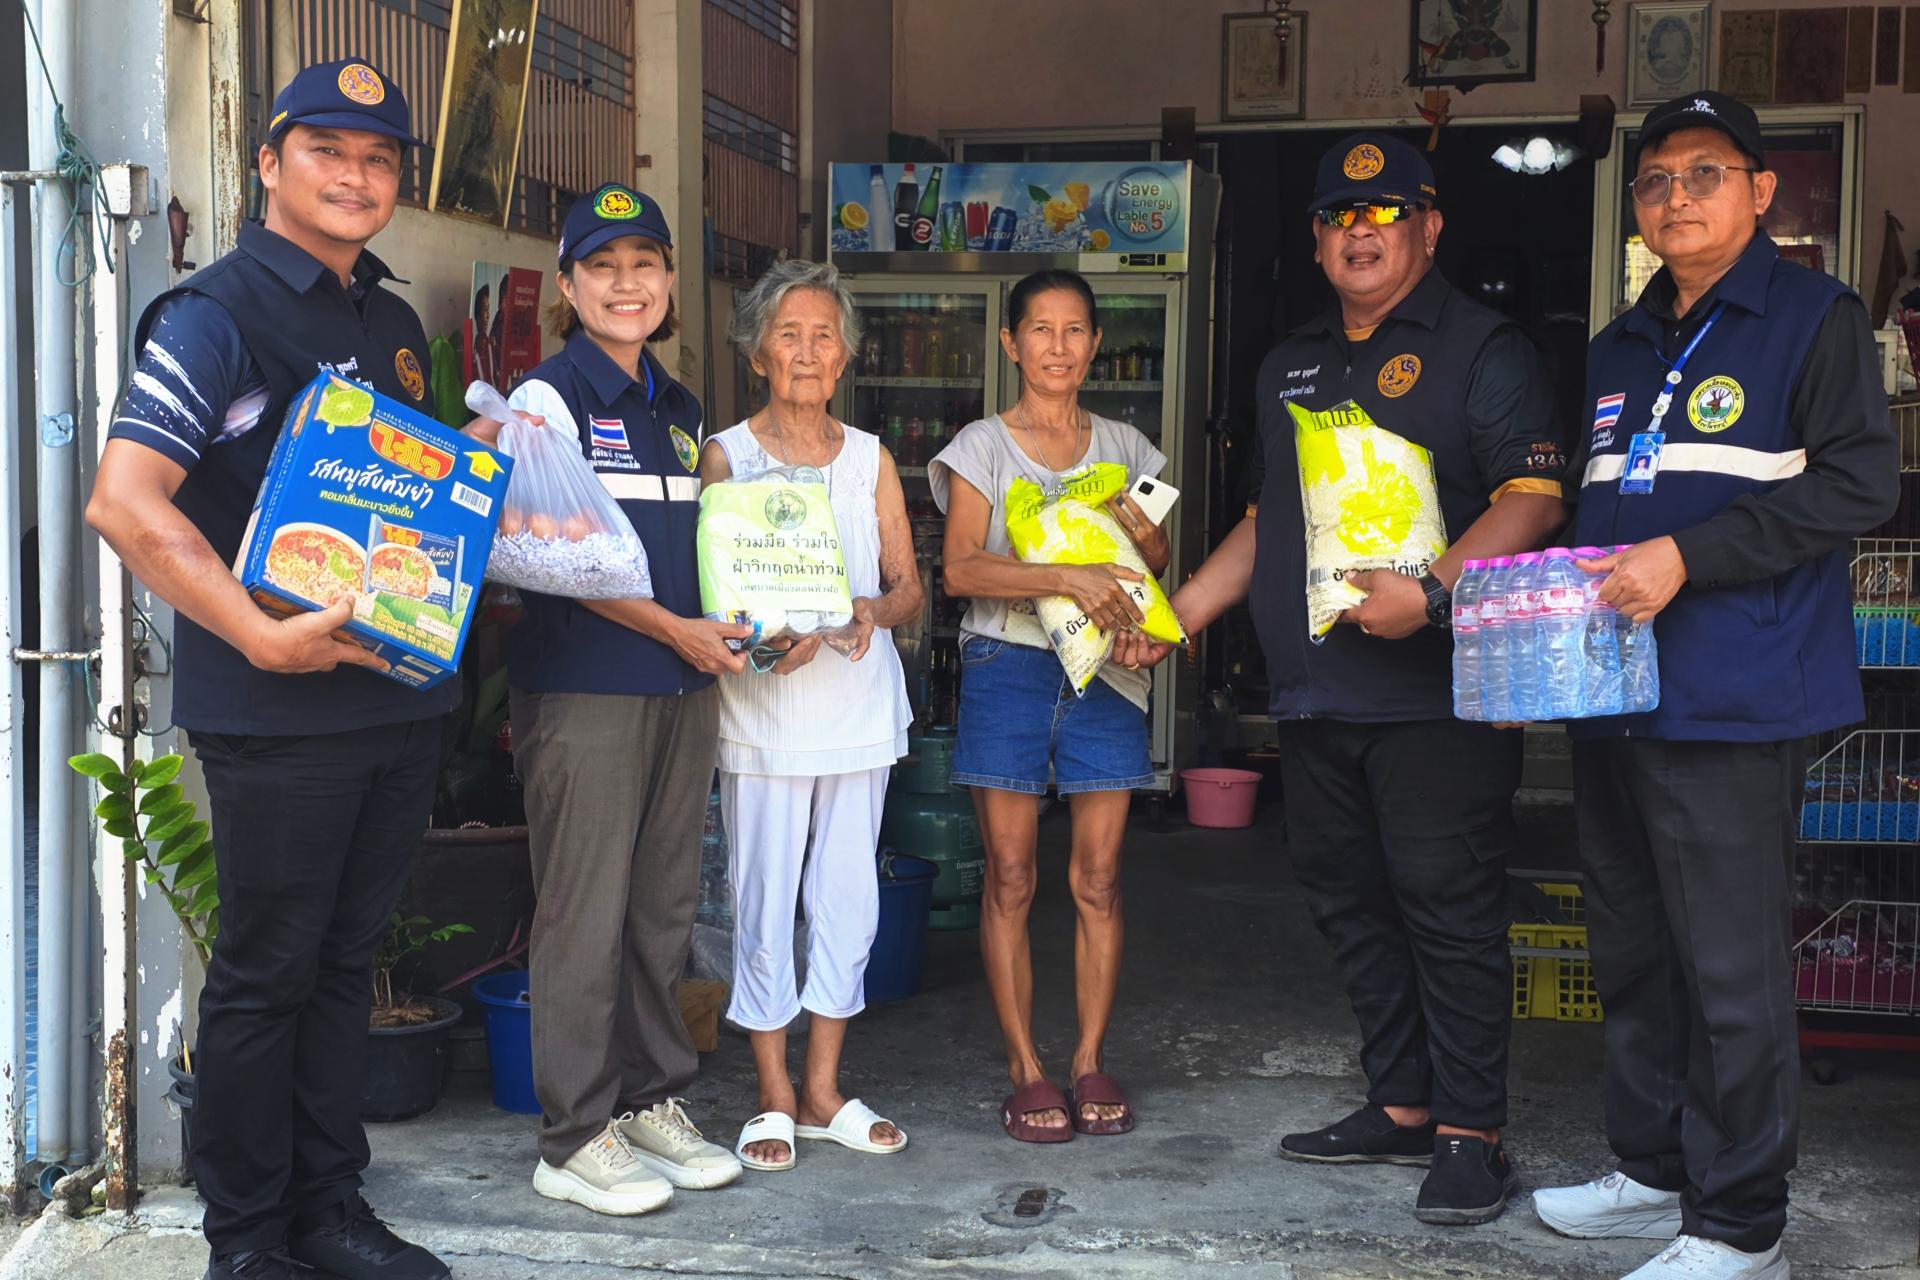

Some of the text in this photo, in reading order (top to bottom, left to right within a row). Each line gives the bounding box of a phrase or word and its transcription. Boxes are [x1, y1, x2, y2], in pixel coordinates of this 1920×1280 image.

[1119, 181, 1161, 197] Save
[1132, 198, 1173, 210] Energy
[1117, 211, 1165, 232] Lable 5
[1130, 221, 1148, 233] No.
[374, 422, 442, 479] ไวไว
[308, 458, 434, 510] รสหมูสับต้มยำ
[319, 488, 414, 519] หอมกลิ่นมะนาวยิ่งขึ้น
[733, 530, 838, 549] ร่วมมือ ร่วมใจ
[732, 554, 845, 577] ฝ่าวิกฤตน้ำท่วม
